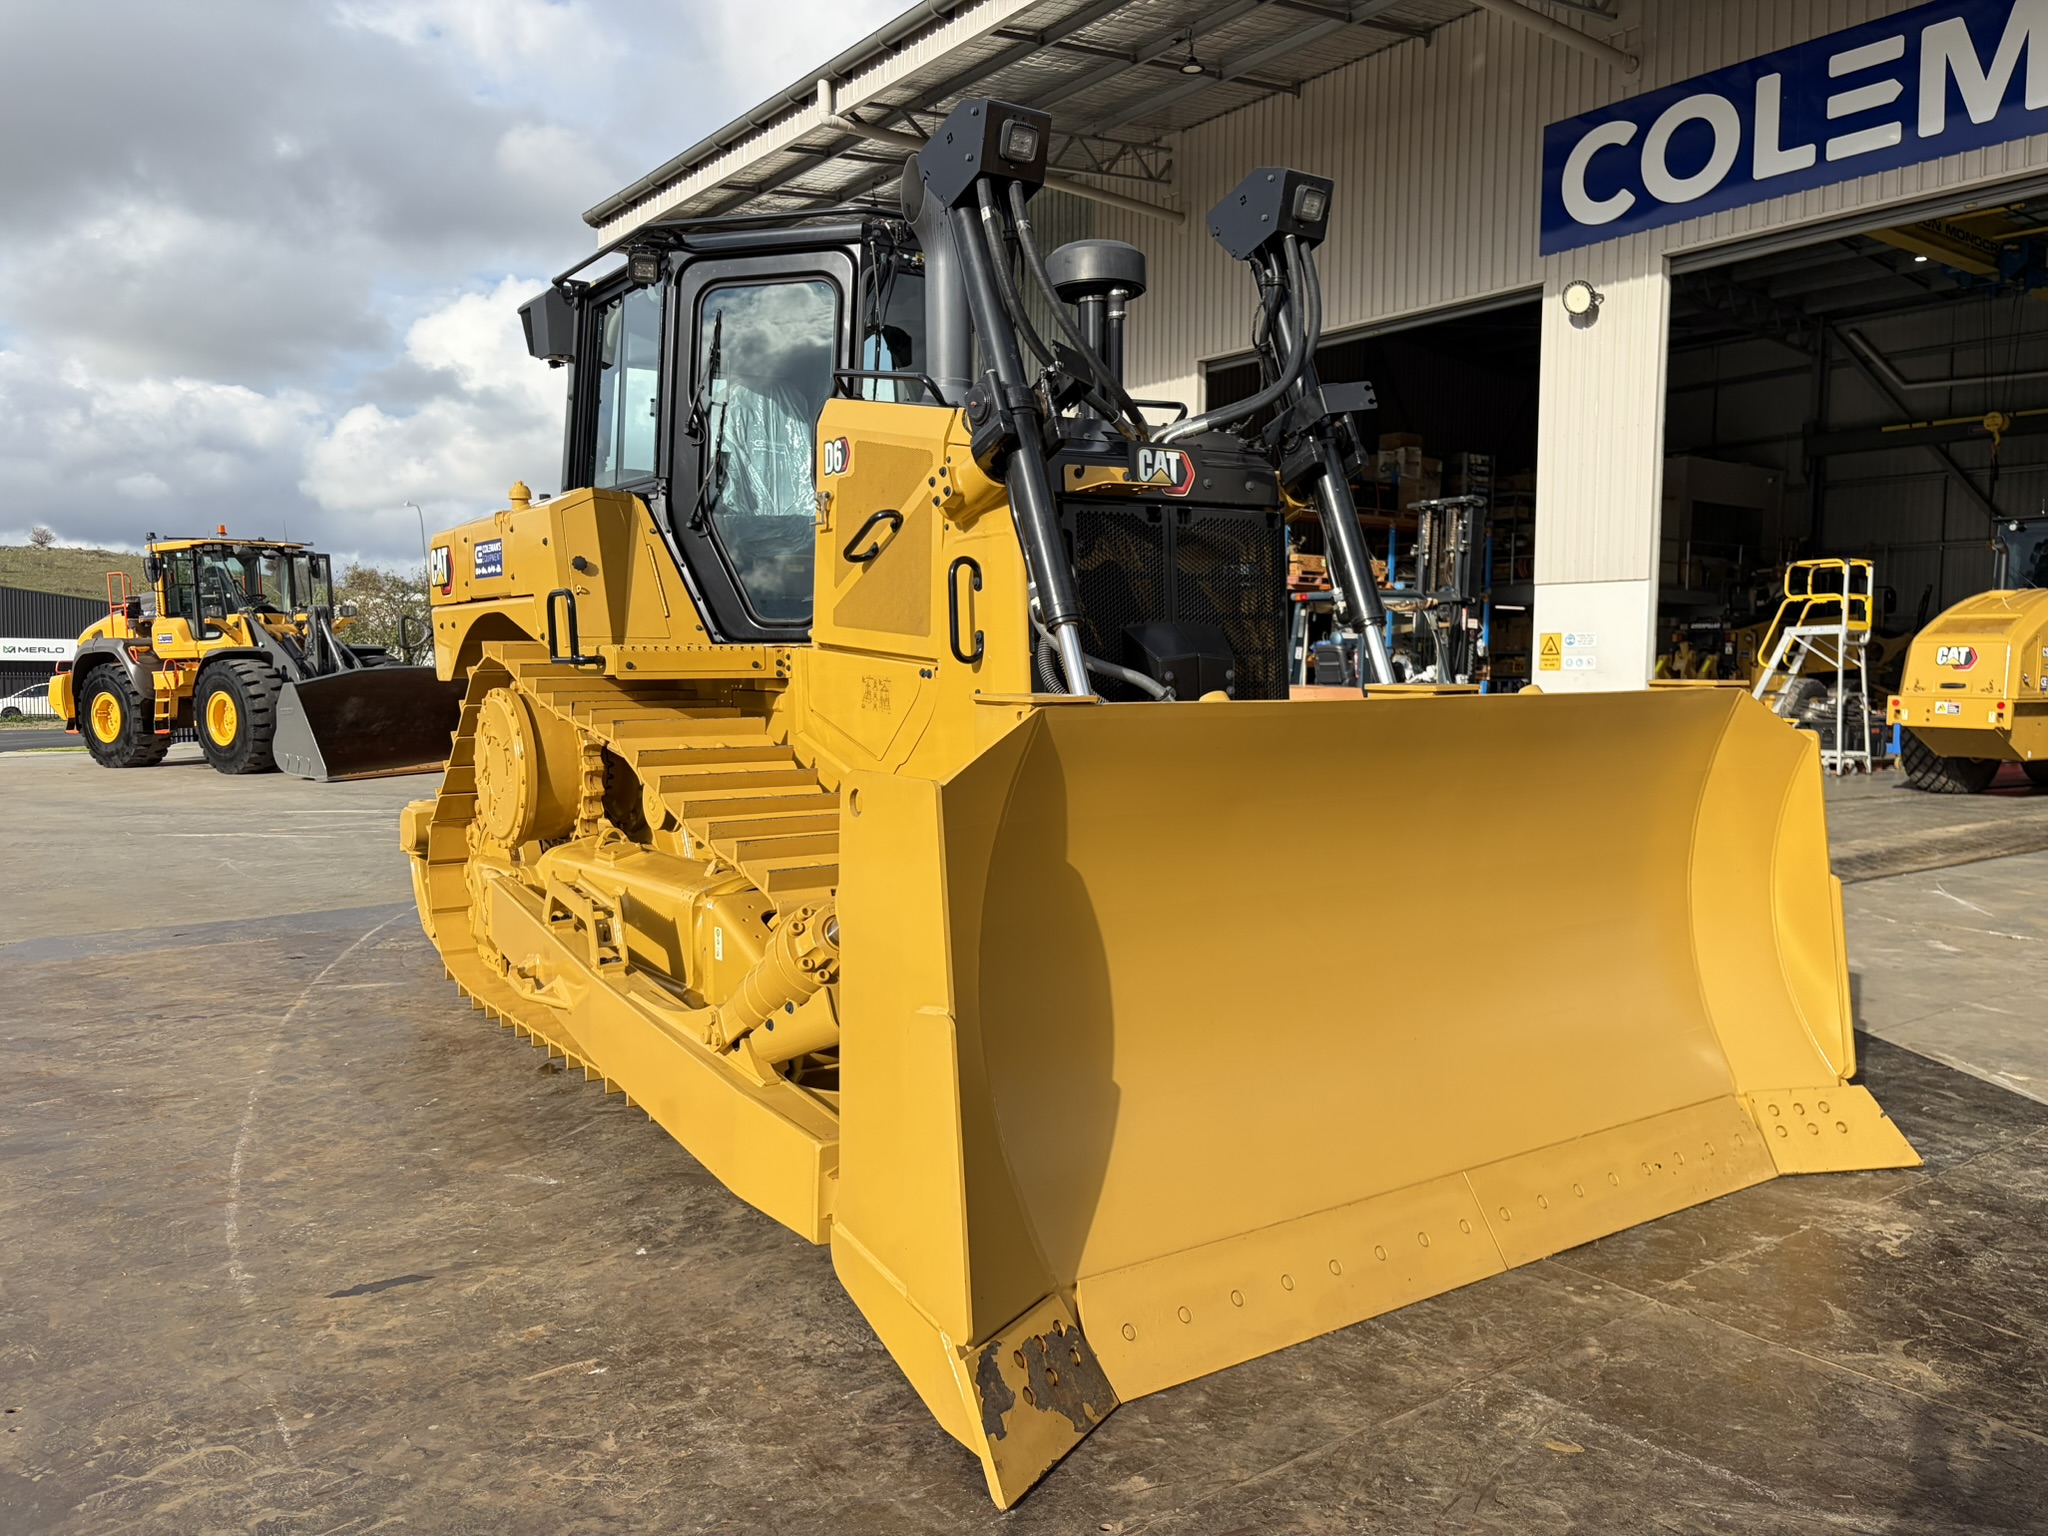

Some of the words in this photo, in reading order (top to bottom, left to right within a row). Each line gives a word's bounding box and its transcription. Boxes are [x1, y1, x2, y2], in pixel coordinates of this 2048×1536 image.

[1561, 0, 2048, 225] COLEM
[1918, 218, 1941, 231] ON
[824, 439, 842, 474] D6
[1138, 449, 1180, 485] CAT
[430, 546, 449, 586] CAT
[18, 646, 65, 654] MERLO
[1936, 646, 1970, 666] CAT
